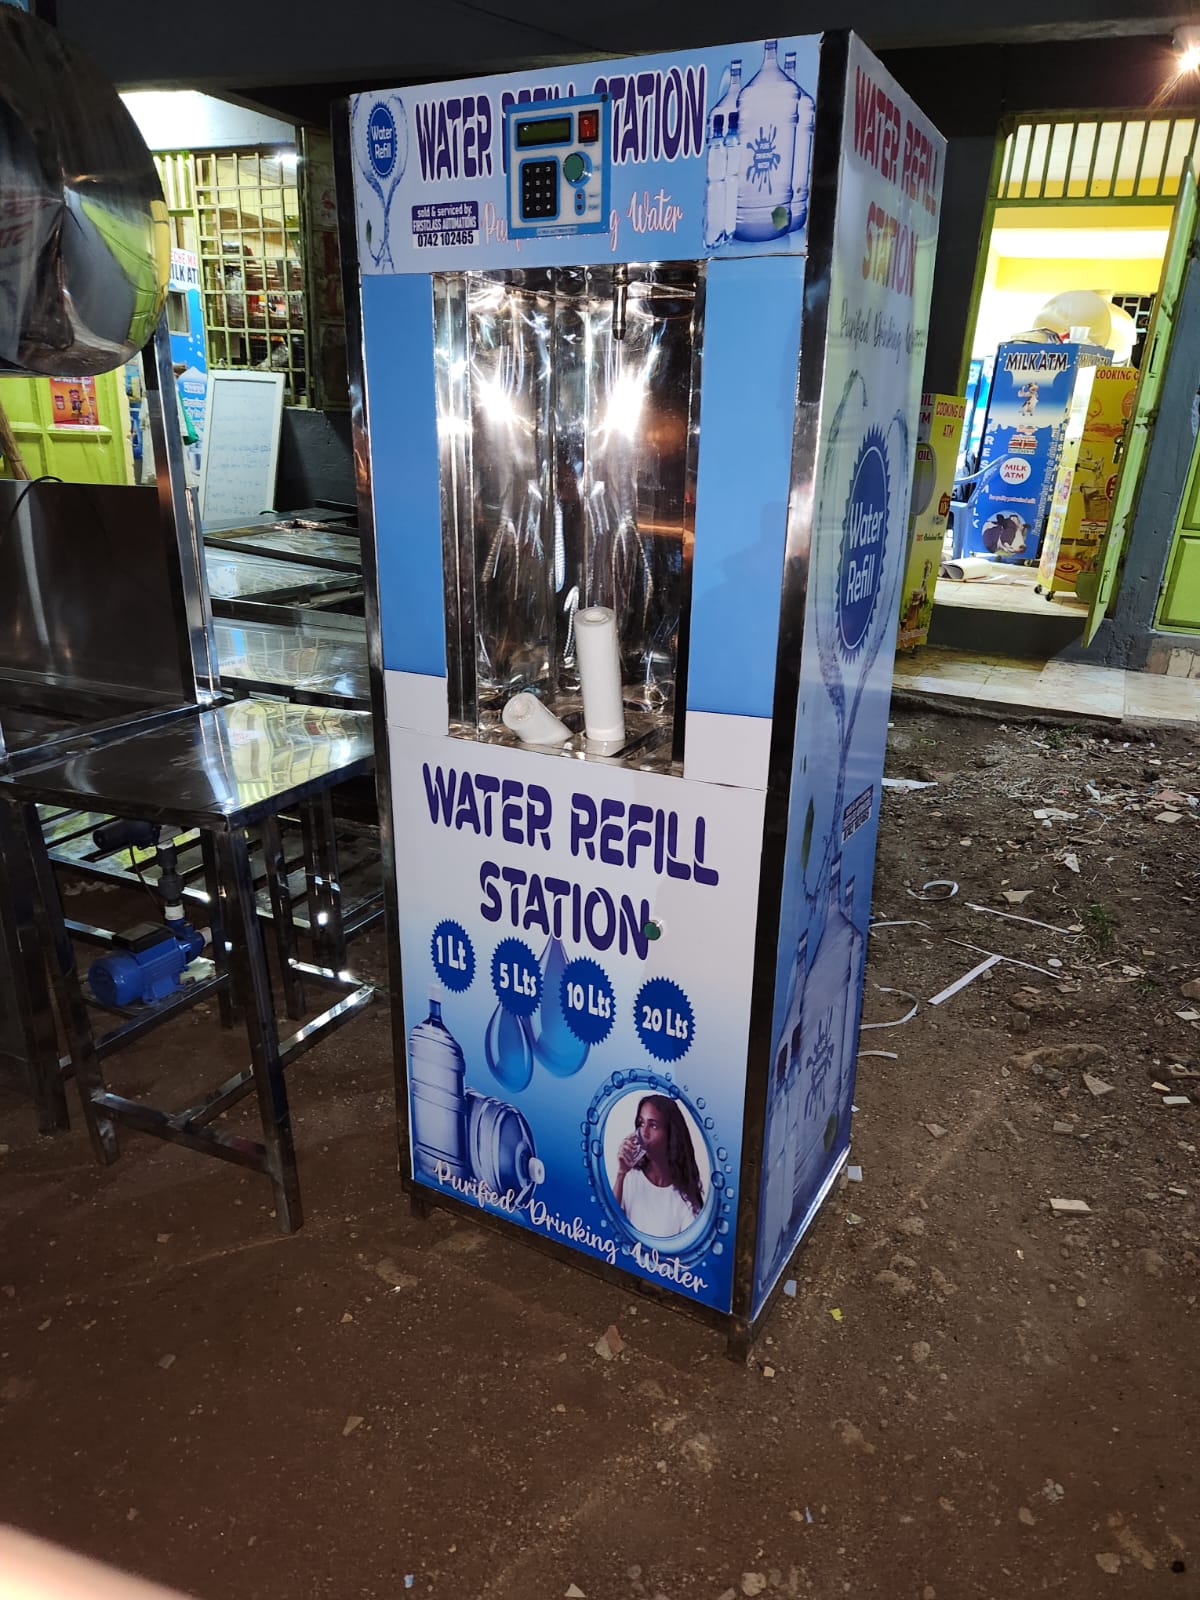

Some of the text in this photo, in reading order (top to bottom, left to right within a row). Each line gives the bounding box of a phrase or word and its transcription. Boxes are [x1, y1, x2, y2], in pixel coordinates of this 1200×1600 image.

[371, 125, 393, 139] Water
[415, 94, 493, 182] WATER
[853, 64, 938, 217] WATER REFILL
[374, 143, 393, 159] Refill
[417, 206, 430, 218] sold
[437, 204, 463, 217] serviced
[626, 188, 684, 234] Water
[417, 230, 474, 248] 0742 102465
[862, 201, 919, 298] STATION
[1004, 352, 1068, 371] MILK ATM
[1095, 369, 1131, 381] COOKING
[1004, 463, 1028, 472] MILK
[1004, 471, 1025, 480] ATM
[849, 500, 884, 550] Water
[846, 553, 875, 606] Refill
[422, 762, 719, 886] WATER REFILL
[479, 860, 650, 961] STATION
[436, 935, 467, 971] 1 Lt
[499, 962, 537, 998] 5 Lts
[566, 982, 611, 1020] 10 Lts
[642, 1004, 688, 1040] 20 Lts
[433, 1160, 708, 1293] Purified Drinking Water
